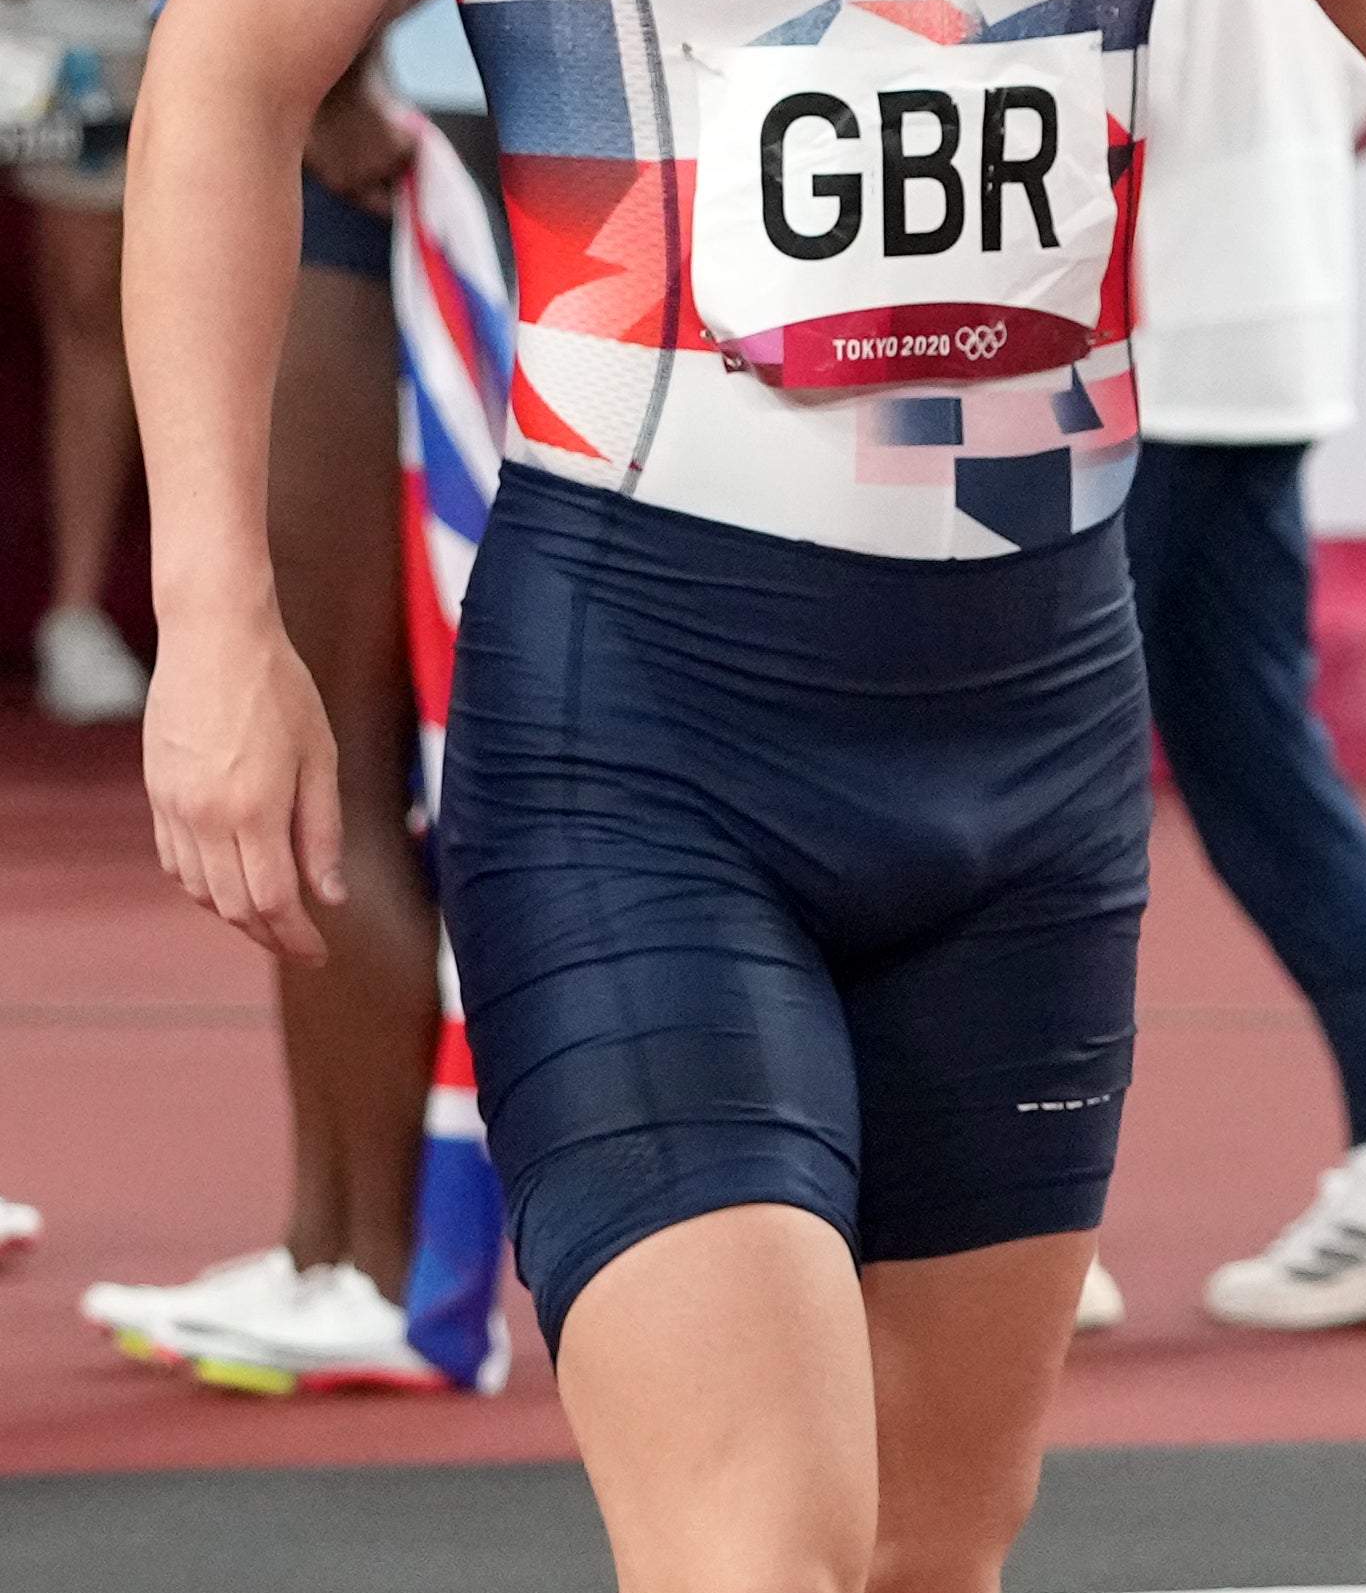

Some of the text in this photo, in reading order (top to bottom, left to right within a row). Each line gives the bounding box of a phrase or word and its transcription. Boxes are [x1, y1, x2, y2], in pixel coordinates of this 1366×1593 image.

[760, 84, 1061, 262] GBR
[832, 334, 951, 362] TOKYO 2020
